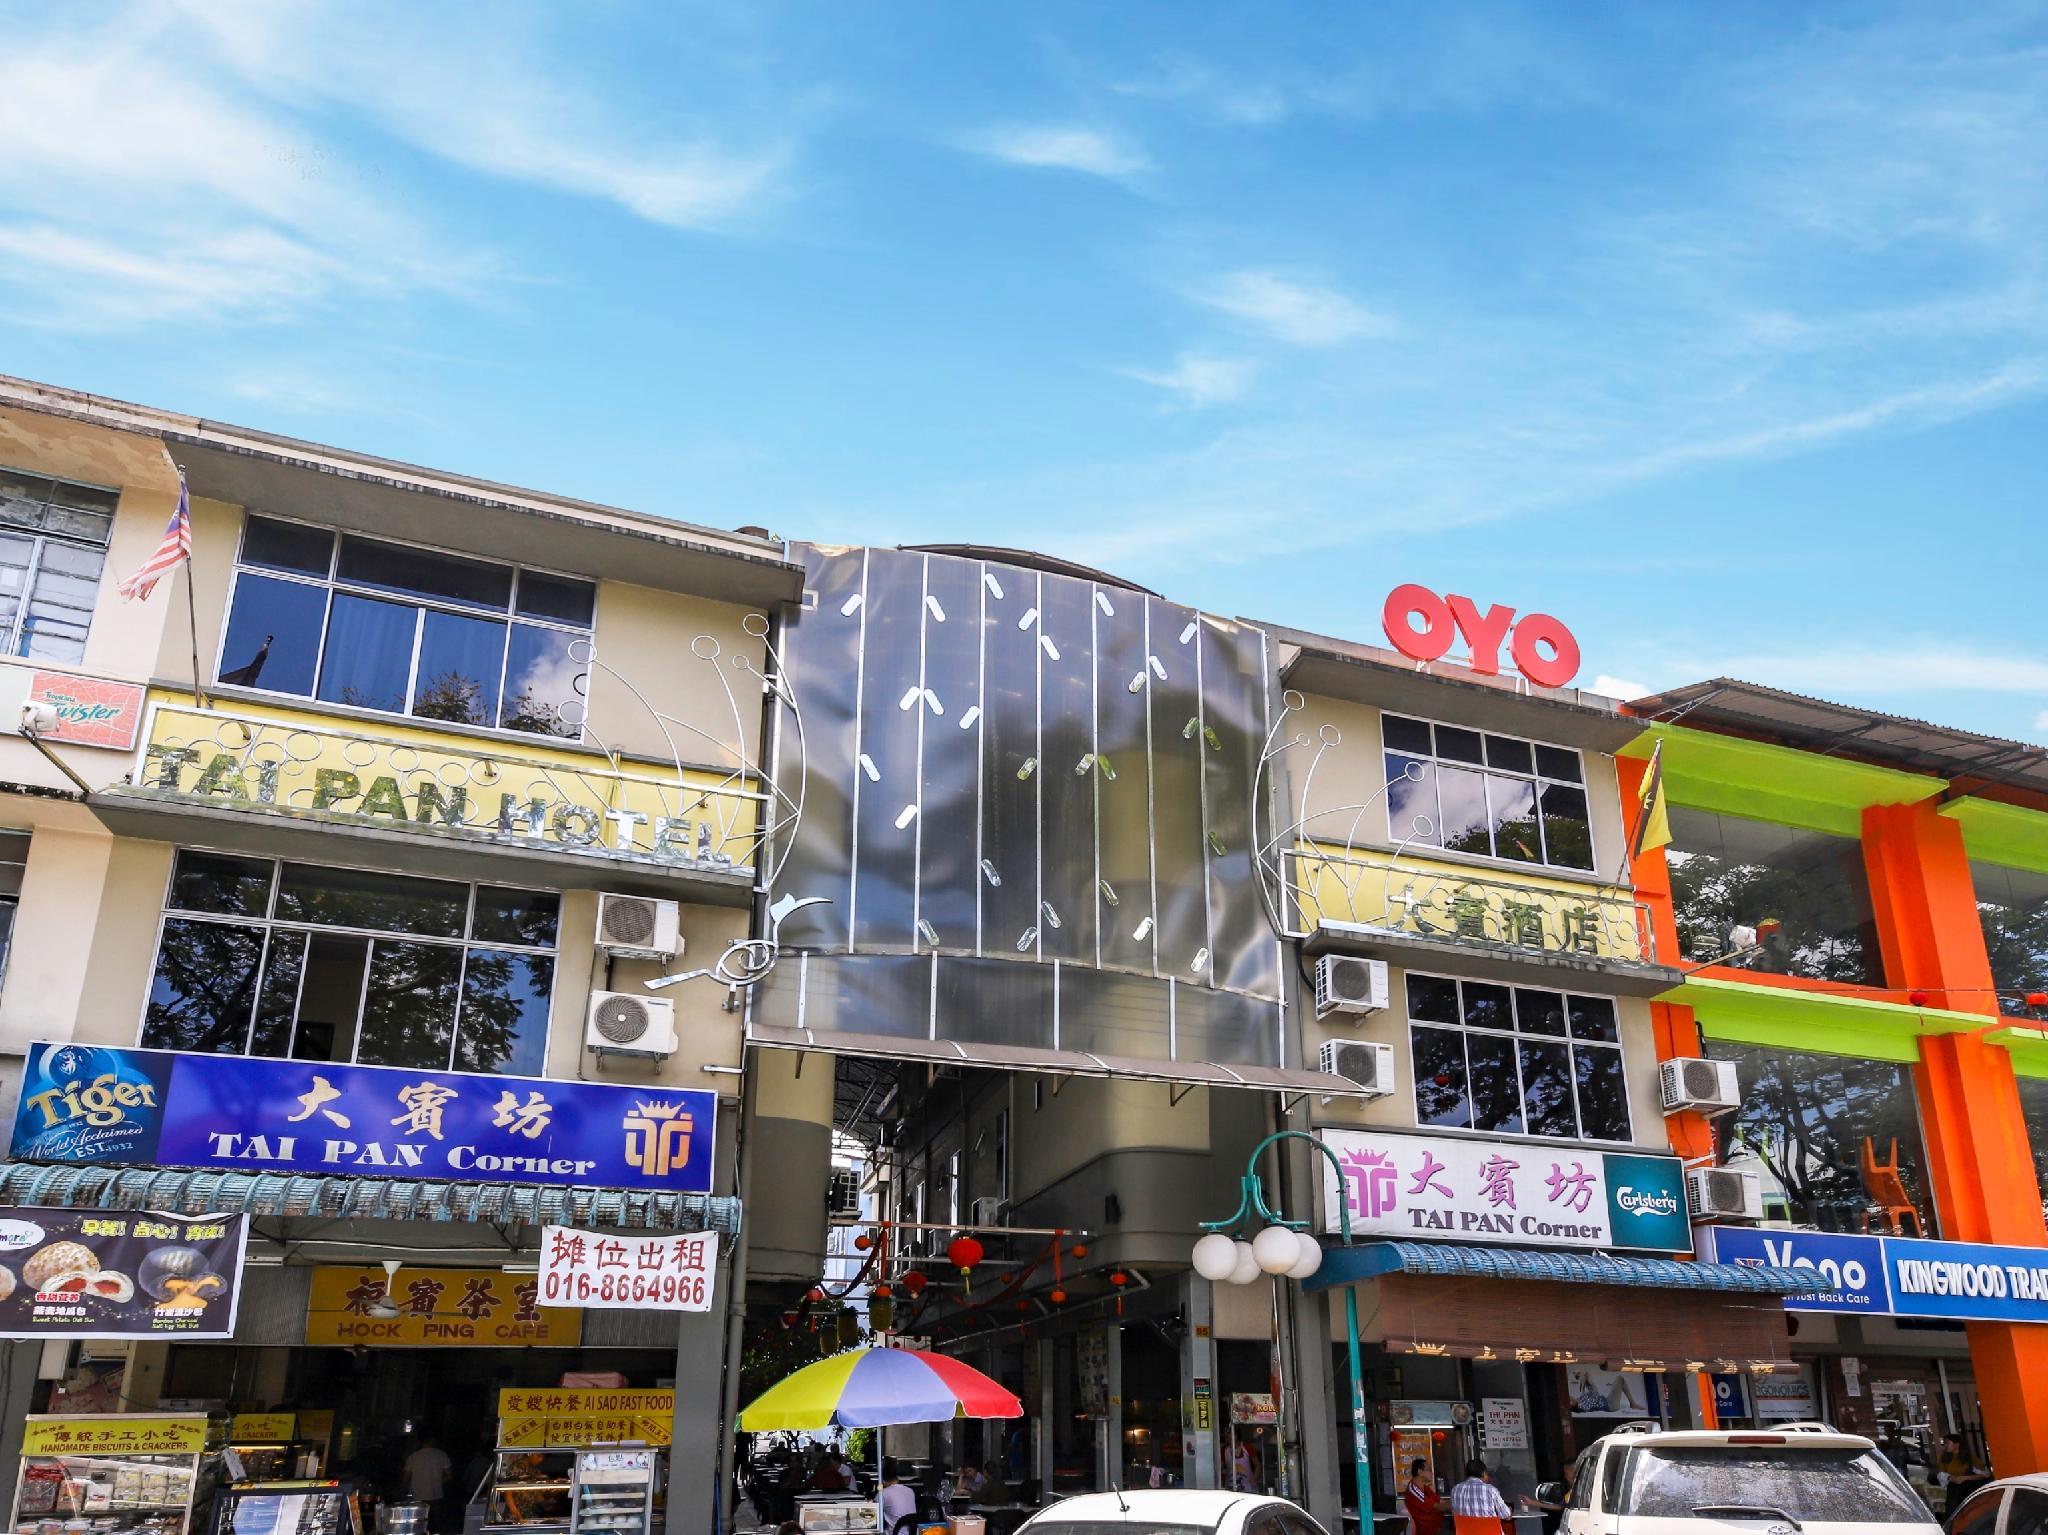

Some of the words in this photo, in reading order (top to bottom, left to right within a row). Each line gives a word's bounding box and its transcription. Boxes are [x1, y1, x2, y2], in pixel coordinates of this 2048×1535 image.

[1382, 583, 1580, 688] OYO
[147, 742, 279, 803] TAI
[312, 767, 466, 830] PAN
[500, 791, 733, 865] HOTEL
[26, 1074, 157, 1129] Tiger
[287, 1075, 553, 1141] 大賓坊
[208, 1132, 298, 1162] TAI
[321, 1139, 426, 1168] PAN
[447, 1145, 597, 1176] Corner
[1407, 1150, 1597, 1213] 大賓坊
[1616, 1186, 1676, 1214] Carlsberg
[1408, 1208, 1454, 1230] TAI
[1459, 1212, 1516, 1234] PAN
[1520, 1216, 1602, 1239] Corner
[550, 1230, 706, 1273] 摊位出租
[545, 1272, 706, 1305] 016-8664966
[1897, 1259, 2007, 1298] KINGWOOD
[1818, 1292, 1844, 1302] Back
[1847, 1293, 1870, 1304] Care
[337, 1323, 402, 1338] HOCK
[423, 1324, 475, 1338] PING
[495, 1325, 549, 1339] CAFE
[584, 1396, 595, 1410] AI
[597, 1396, 618, 1410] SAO
[619, 1396, 642, 1410] FAST
[644, 1396, 673, 1410] FOOD
[1503, 1411, 1521, 1419] PAN
[40, 1443, 91, 1453] HANDMADE
[92, 1442, 132, 1452] BISCUITS
[133, 1442, 140, 1450] &
[141, 1441, 188, 1451] CRACKERS
